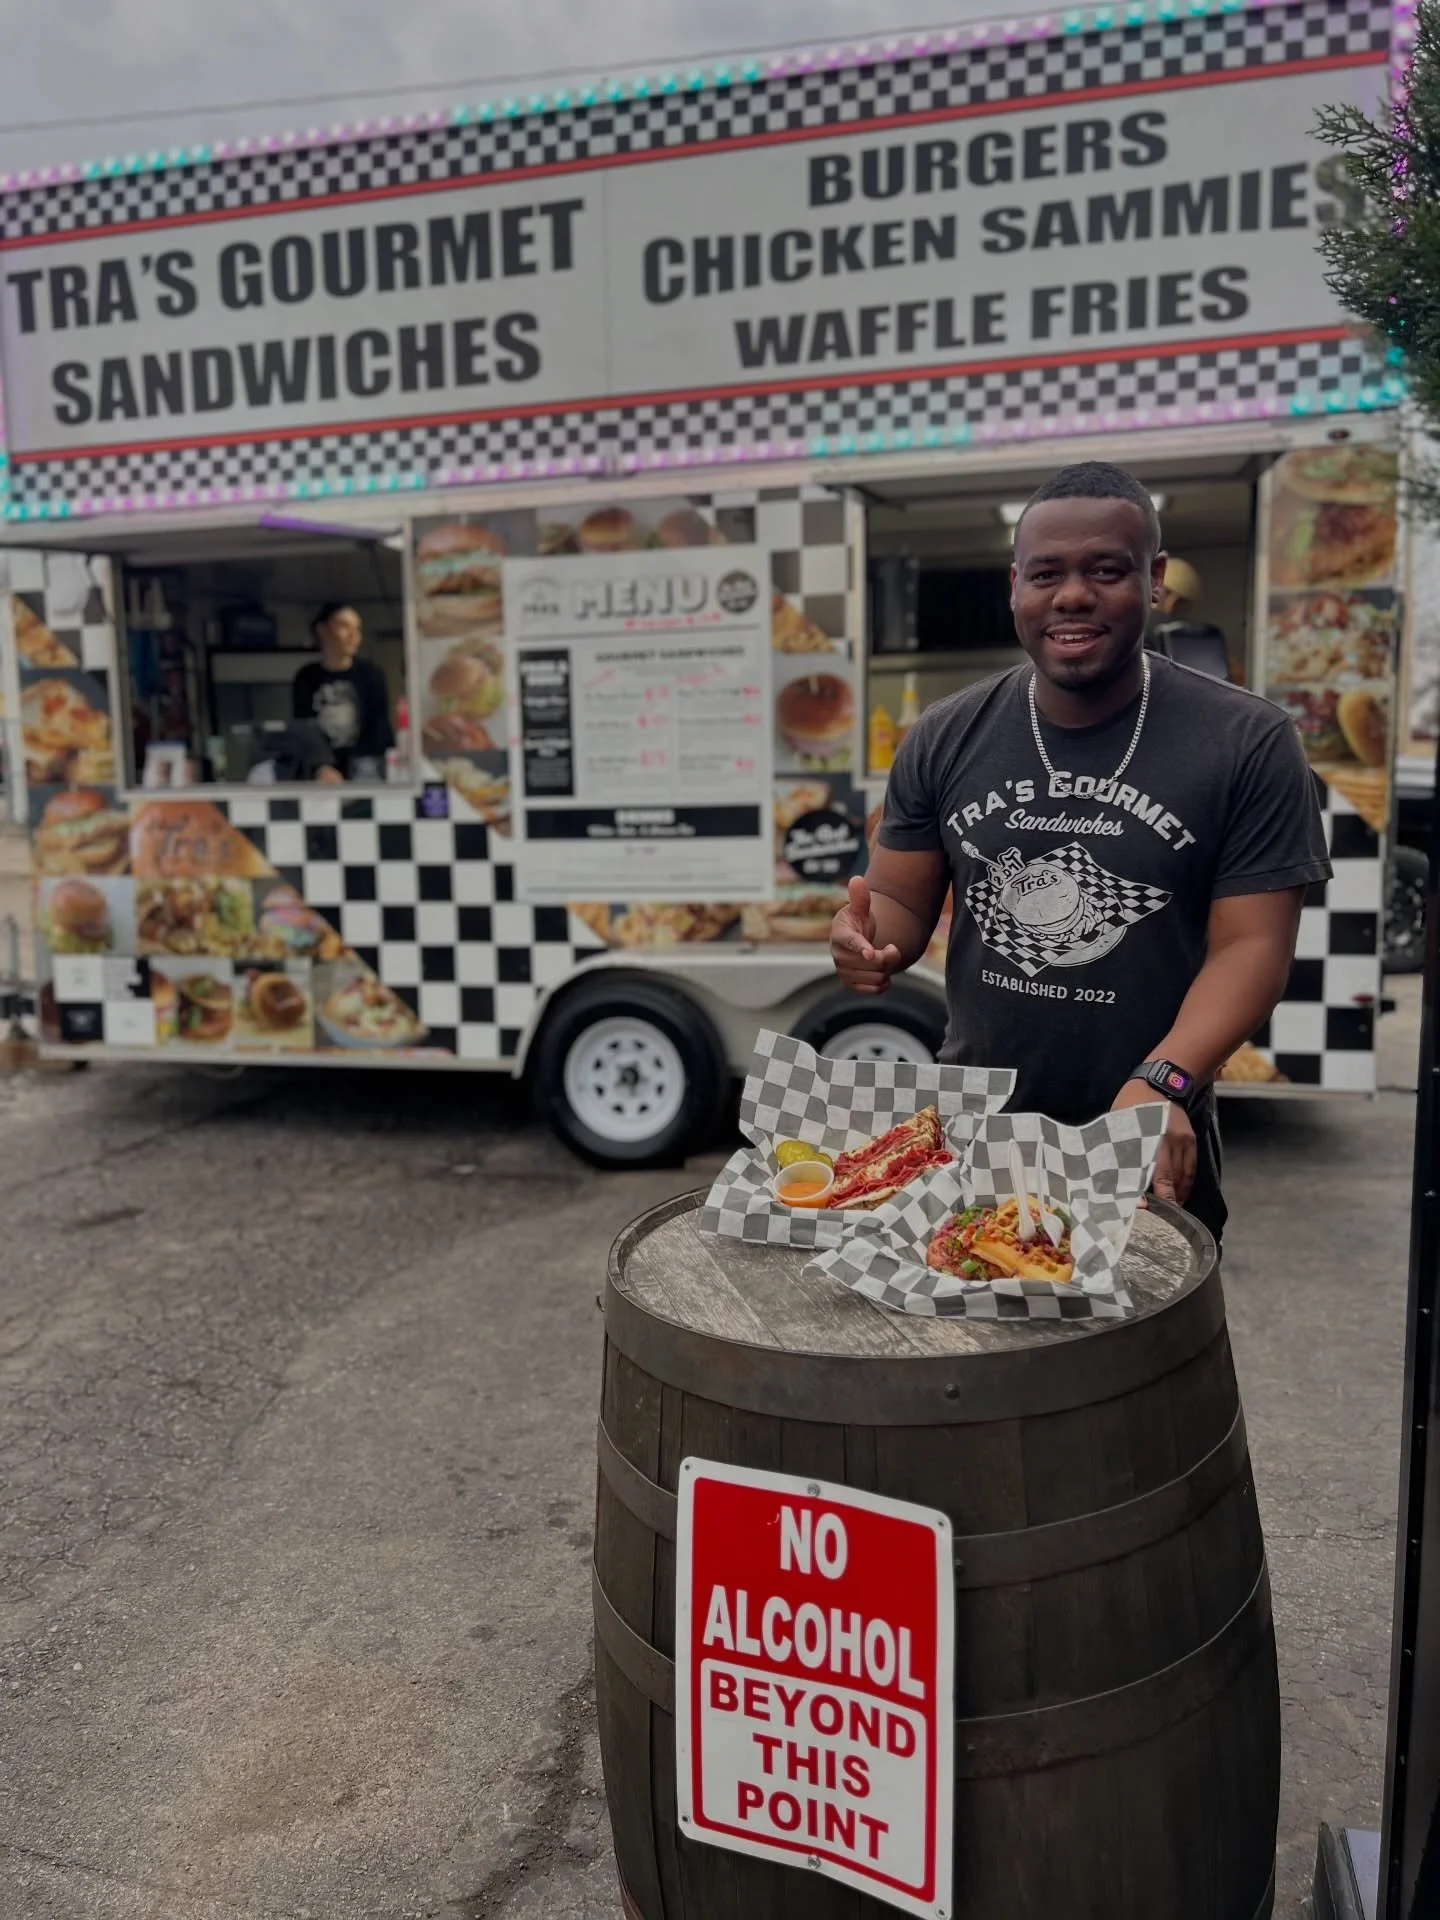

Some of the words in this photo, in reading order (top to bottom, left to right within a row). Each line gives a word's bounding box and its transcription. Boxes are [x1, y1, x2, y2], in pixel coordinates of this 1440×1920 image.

[808, 109, 1168, 208] BURGERS
[7, 249, 199, 334] TRA'S
[218, 198, 585, 310] GOURMET
[643, 216, 955, 306] CHICKEN
[982, 153, 1365, 256] SAMMIES
[734, 291, 1006, 369] WAFFLE
[1031, 265, 1250, 341] FRIES
[51, 312, 543, 427] SANDWICHES
[574, 576, 707, 620] MENU
[947, 778, 1036, 837] TRA'S
[1048, 770, 1197, 852] GOURMET
[1004, 808, 1125, 836] Sandwiches
[1013, 871, 1060, 895] Tra's
[982, 969, 1068, 1000] ESTABLISHED
[1074, 988, 1117, 1004] 2022
[779, 1505, 848, 1580] NO
[703, 1584, 925, 1700] ALCOHOL
[709, 1670, 916, 1759] BEYOND
[753, 1733, 871, 1798] THIS
[737, 1781, 889, 1861] POINT
